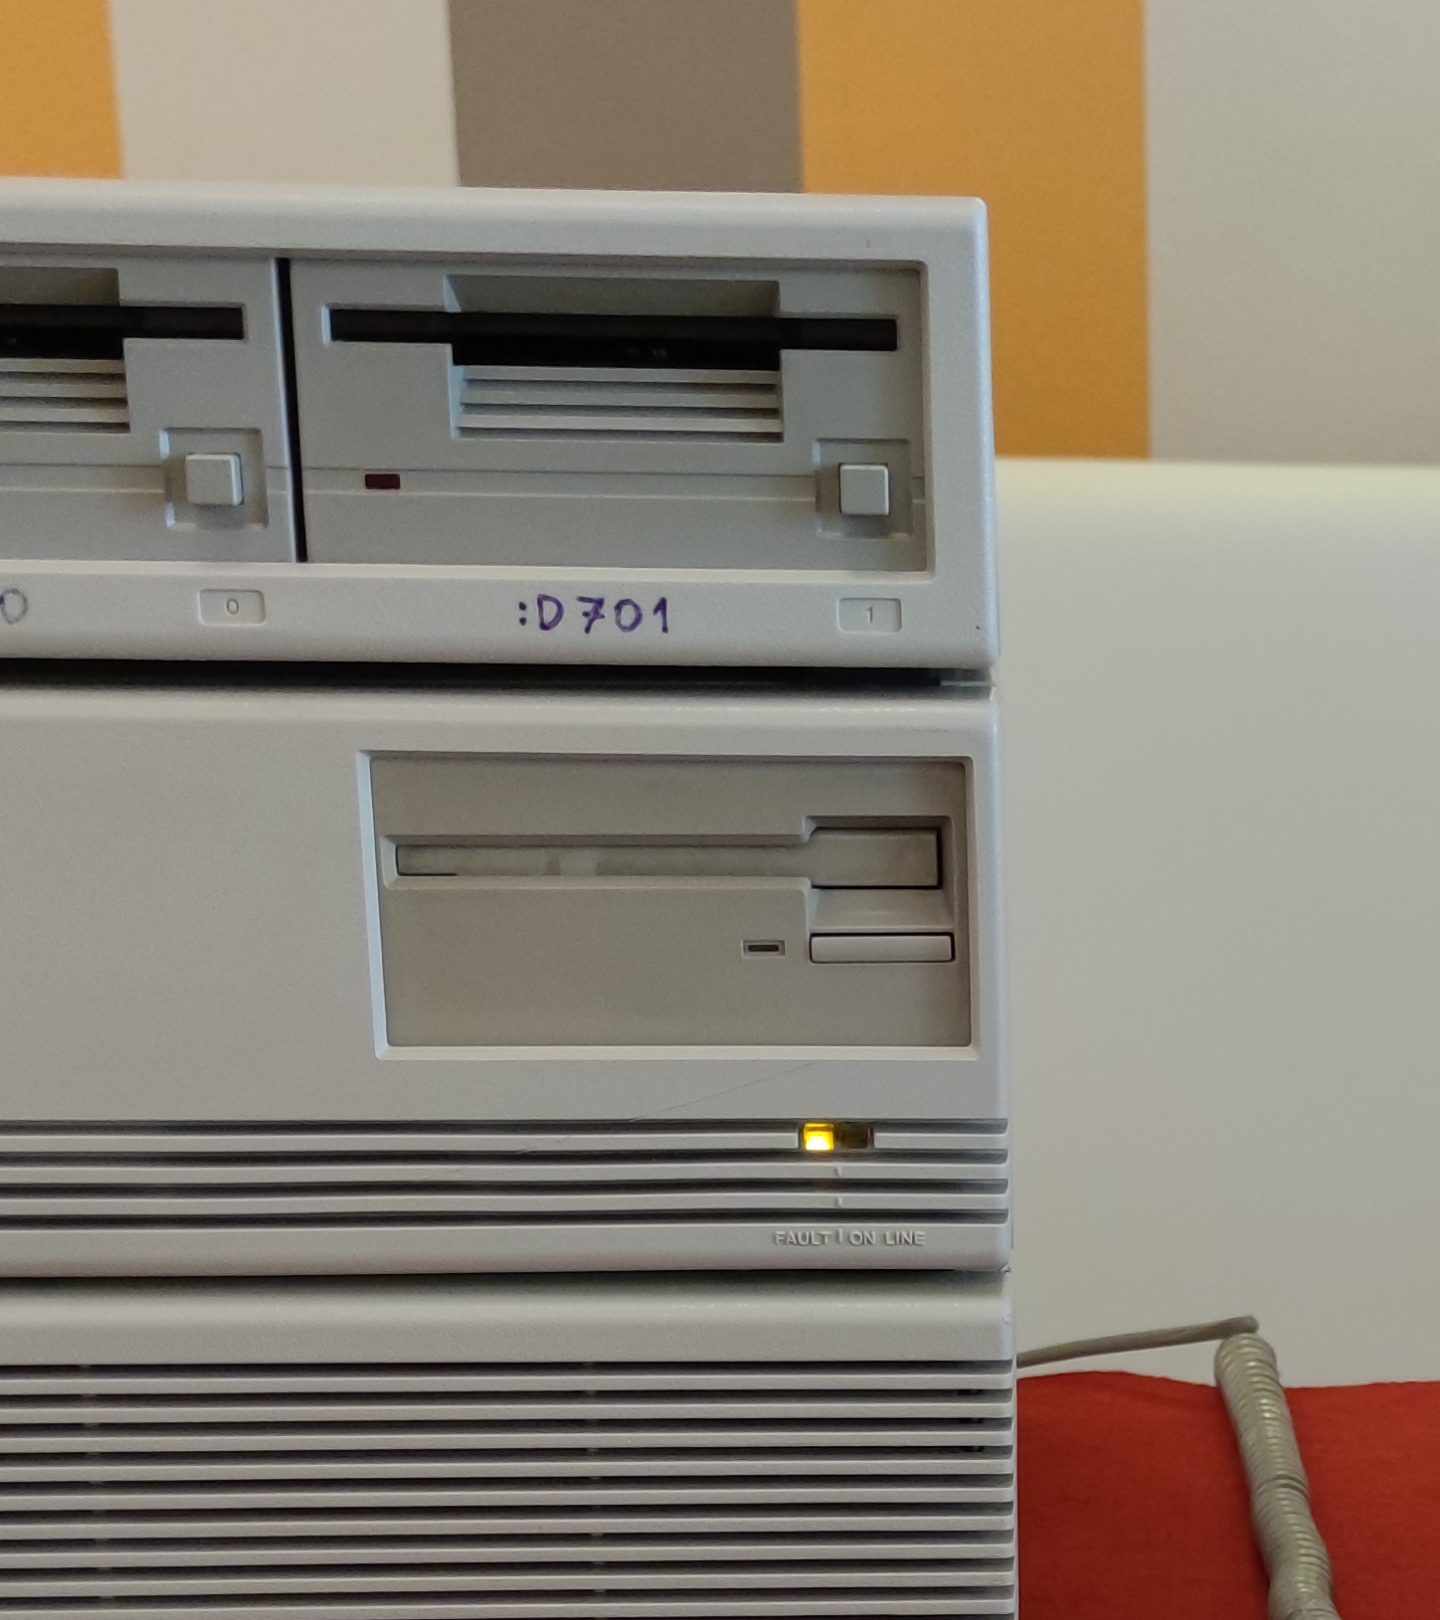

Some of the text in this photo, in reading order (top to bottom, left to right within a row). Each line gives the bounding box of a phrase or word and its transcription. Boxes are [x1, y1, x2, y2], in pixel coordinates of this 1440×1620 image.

[576, 595, 669, 634] 701
[774, 1231, 926, 1246] FAULT ON LINE
